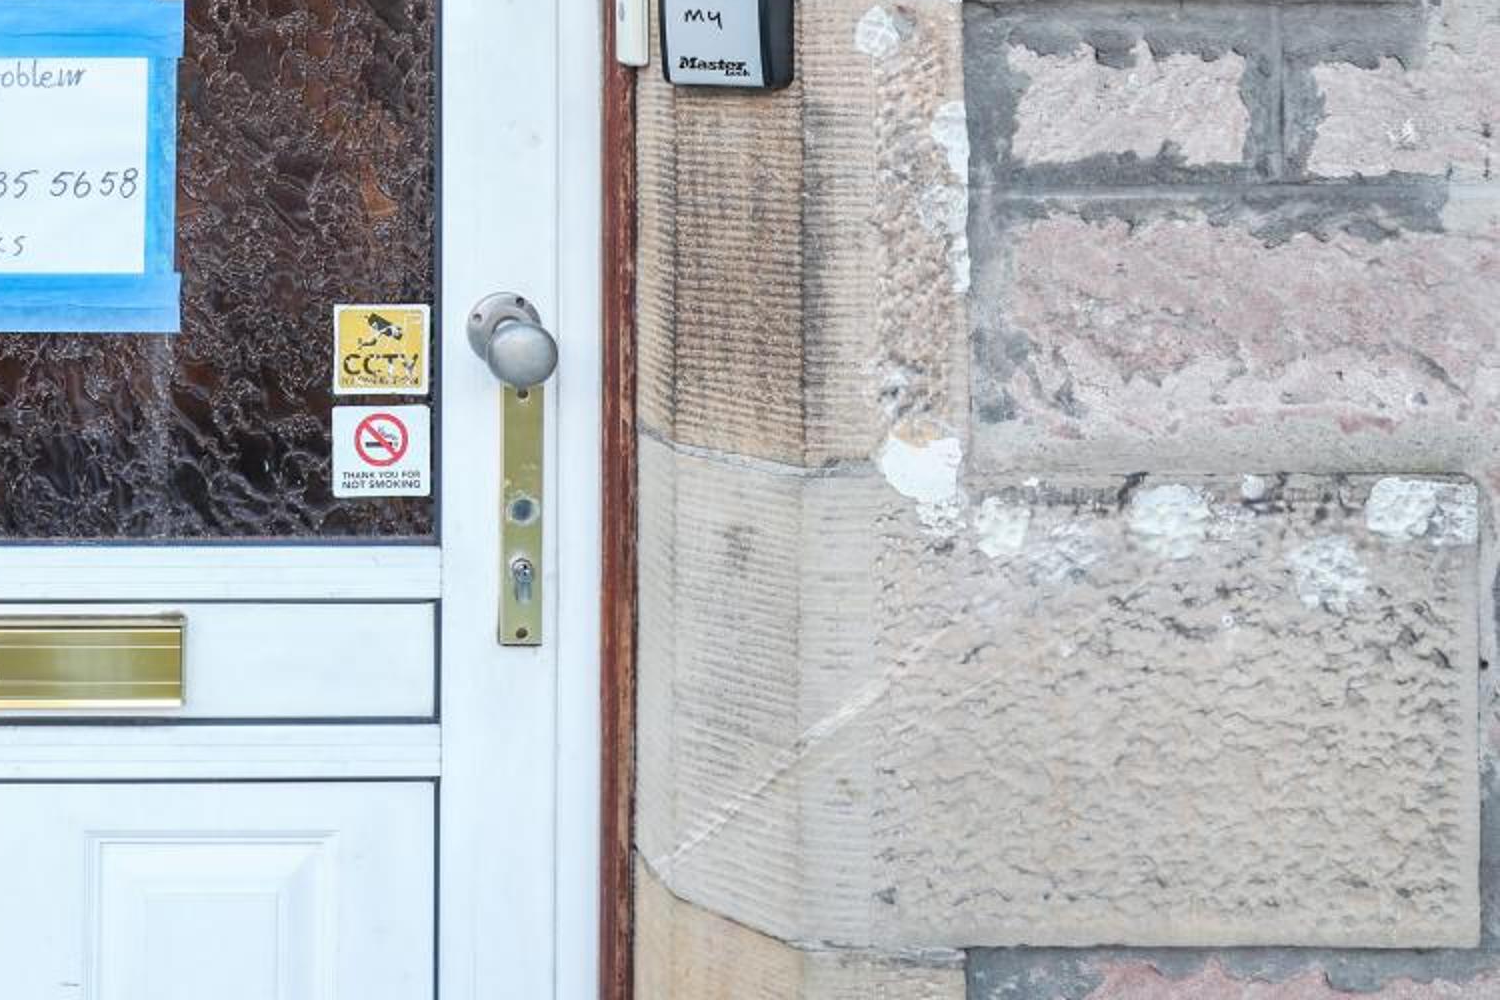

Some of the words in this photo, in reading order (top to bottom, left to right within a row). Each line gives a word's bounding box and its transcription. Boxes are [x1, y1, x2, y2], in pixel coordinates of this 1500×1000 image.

[679, 56, 747, 71] Master
[50, 167, 139, 200] 5658
[343, 353, 419, 377] CCTV
[342, 471, 374, 479] THANK
[378, 471, 398, 479] YOU
[402, 471, 420, 479] FOR
[342, 480, 364, 489] NOT
[369, 480, 420, 489] SMOKING
